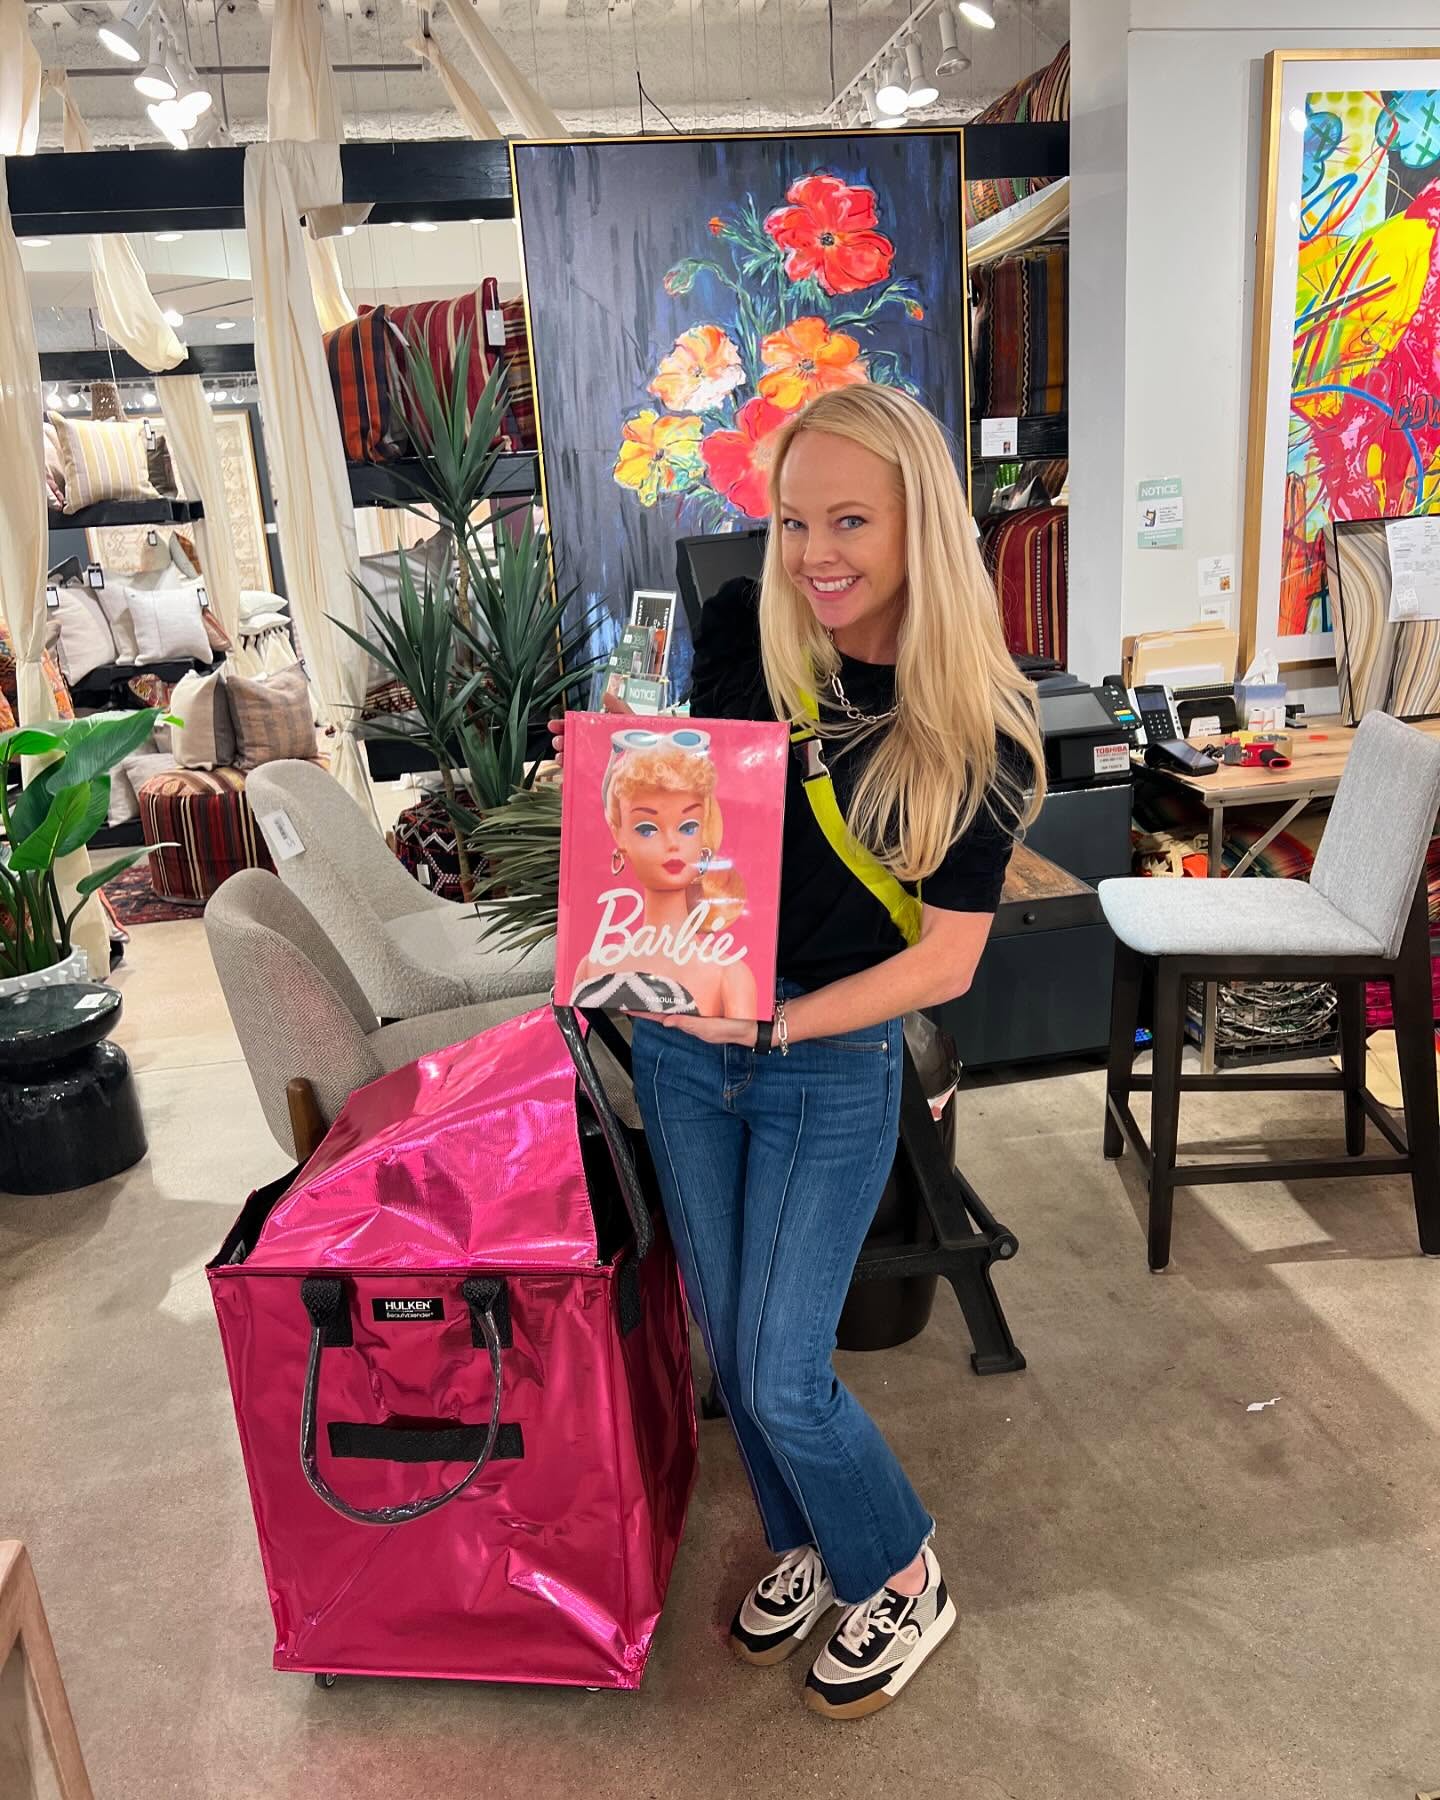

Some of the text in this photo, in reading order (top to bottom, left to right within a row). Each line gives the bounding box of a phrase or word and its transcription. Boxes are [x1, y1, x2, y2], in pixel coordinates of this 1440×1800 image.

[1141, 484, 1178, 496] NOTICE
[629, 687, 656, 700] NOTICE
[1096, 745, 1127, 753] TOSHIBA
[588, 887, 748, 966] Barbie
[384, 1301, 431, 1310] HULKEN
